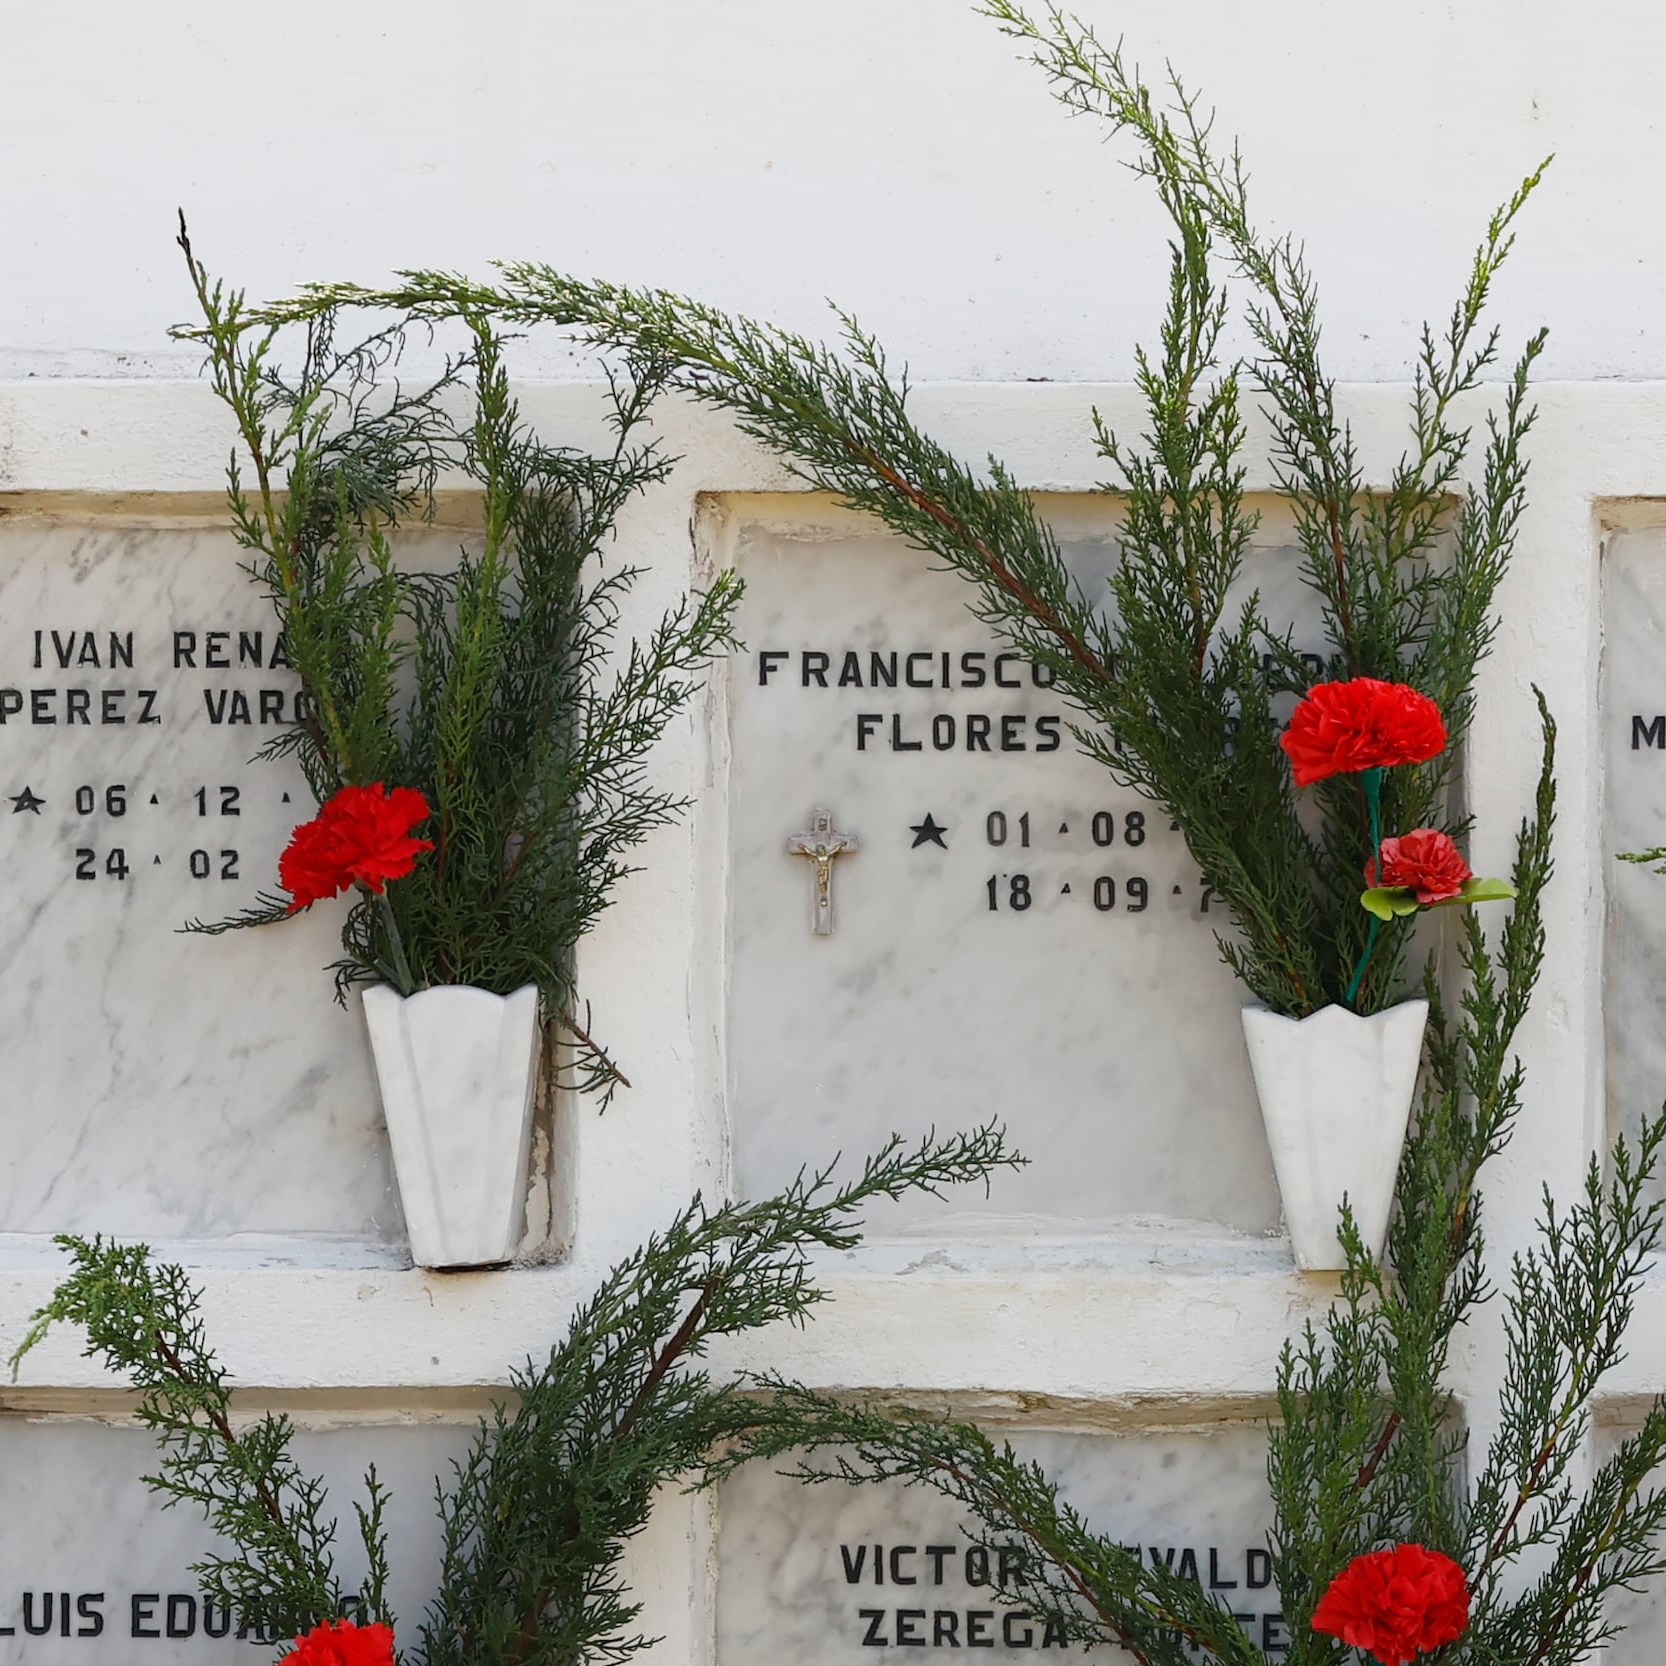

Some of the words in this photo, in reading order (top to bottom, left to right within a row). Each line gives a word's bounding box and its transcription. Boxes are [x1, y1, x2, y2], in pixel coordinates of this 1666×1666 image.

[32, 629, 134, 669] IVAN
[172, 630, 294, 669] RENA
[757, 650, 1057, 689] FRANCISCO
[856, 714, 1061, 752] FLORES
[75, 785, 127, 817] 06
[195, 785, 241, 817] 12
[985, 810, 1031, 848] 01
[1091, 810, 1146, 847] 08
[75, 847, 130, 880] 24
[190, 848, 240, 880] 02
[986, 874, 1033, 912] 18
[1093, 875, 1149, 912] 09
[840, 1544, 1029, 1588] VICTOR
[130, 1593, 370, 1640] EDUO
[859, 1608, 1070, 1649] ZEREGA
